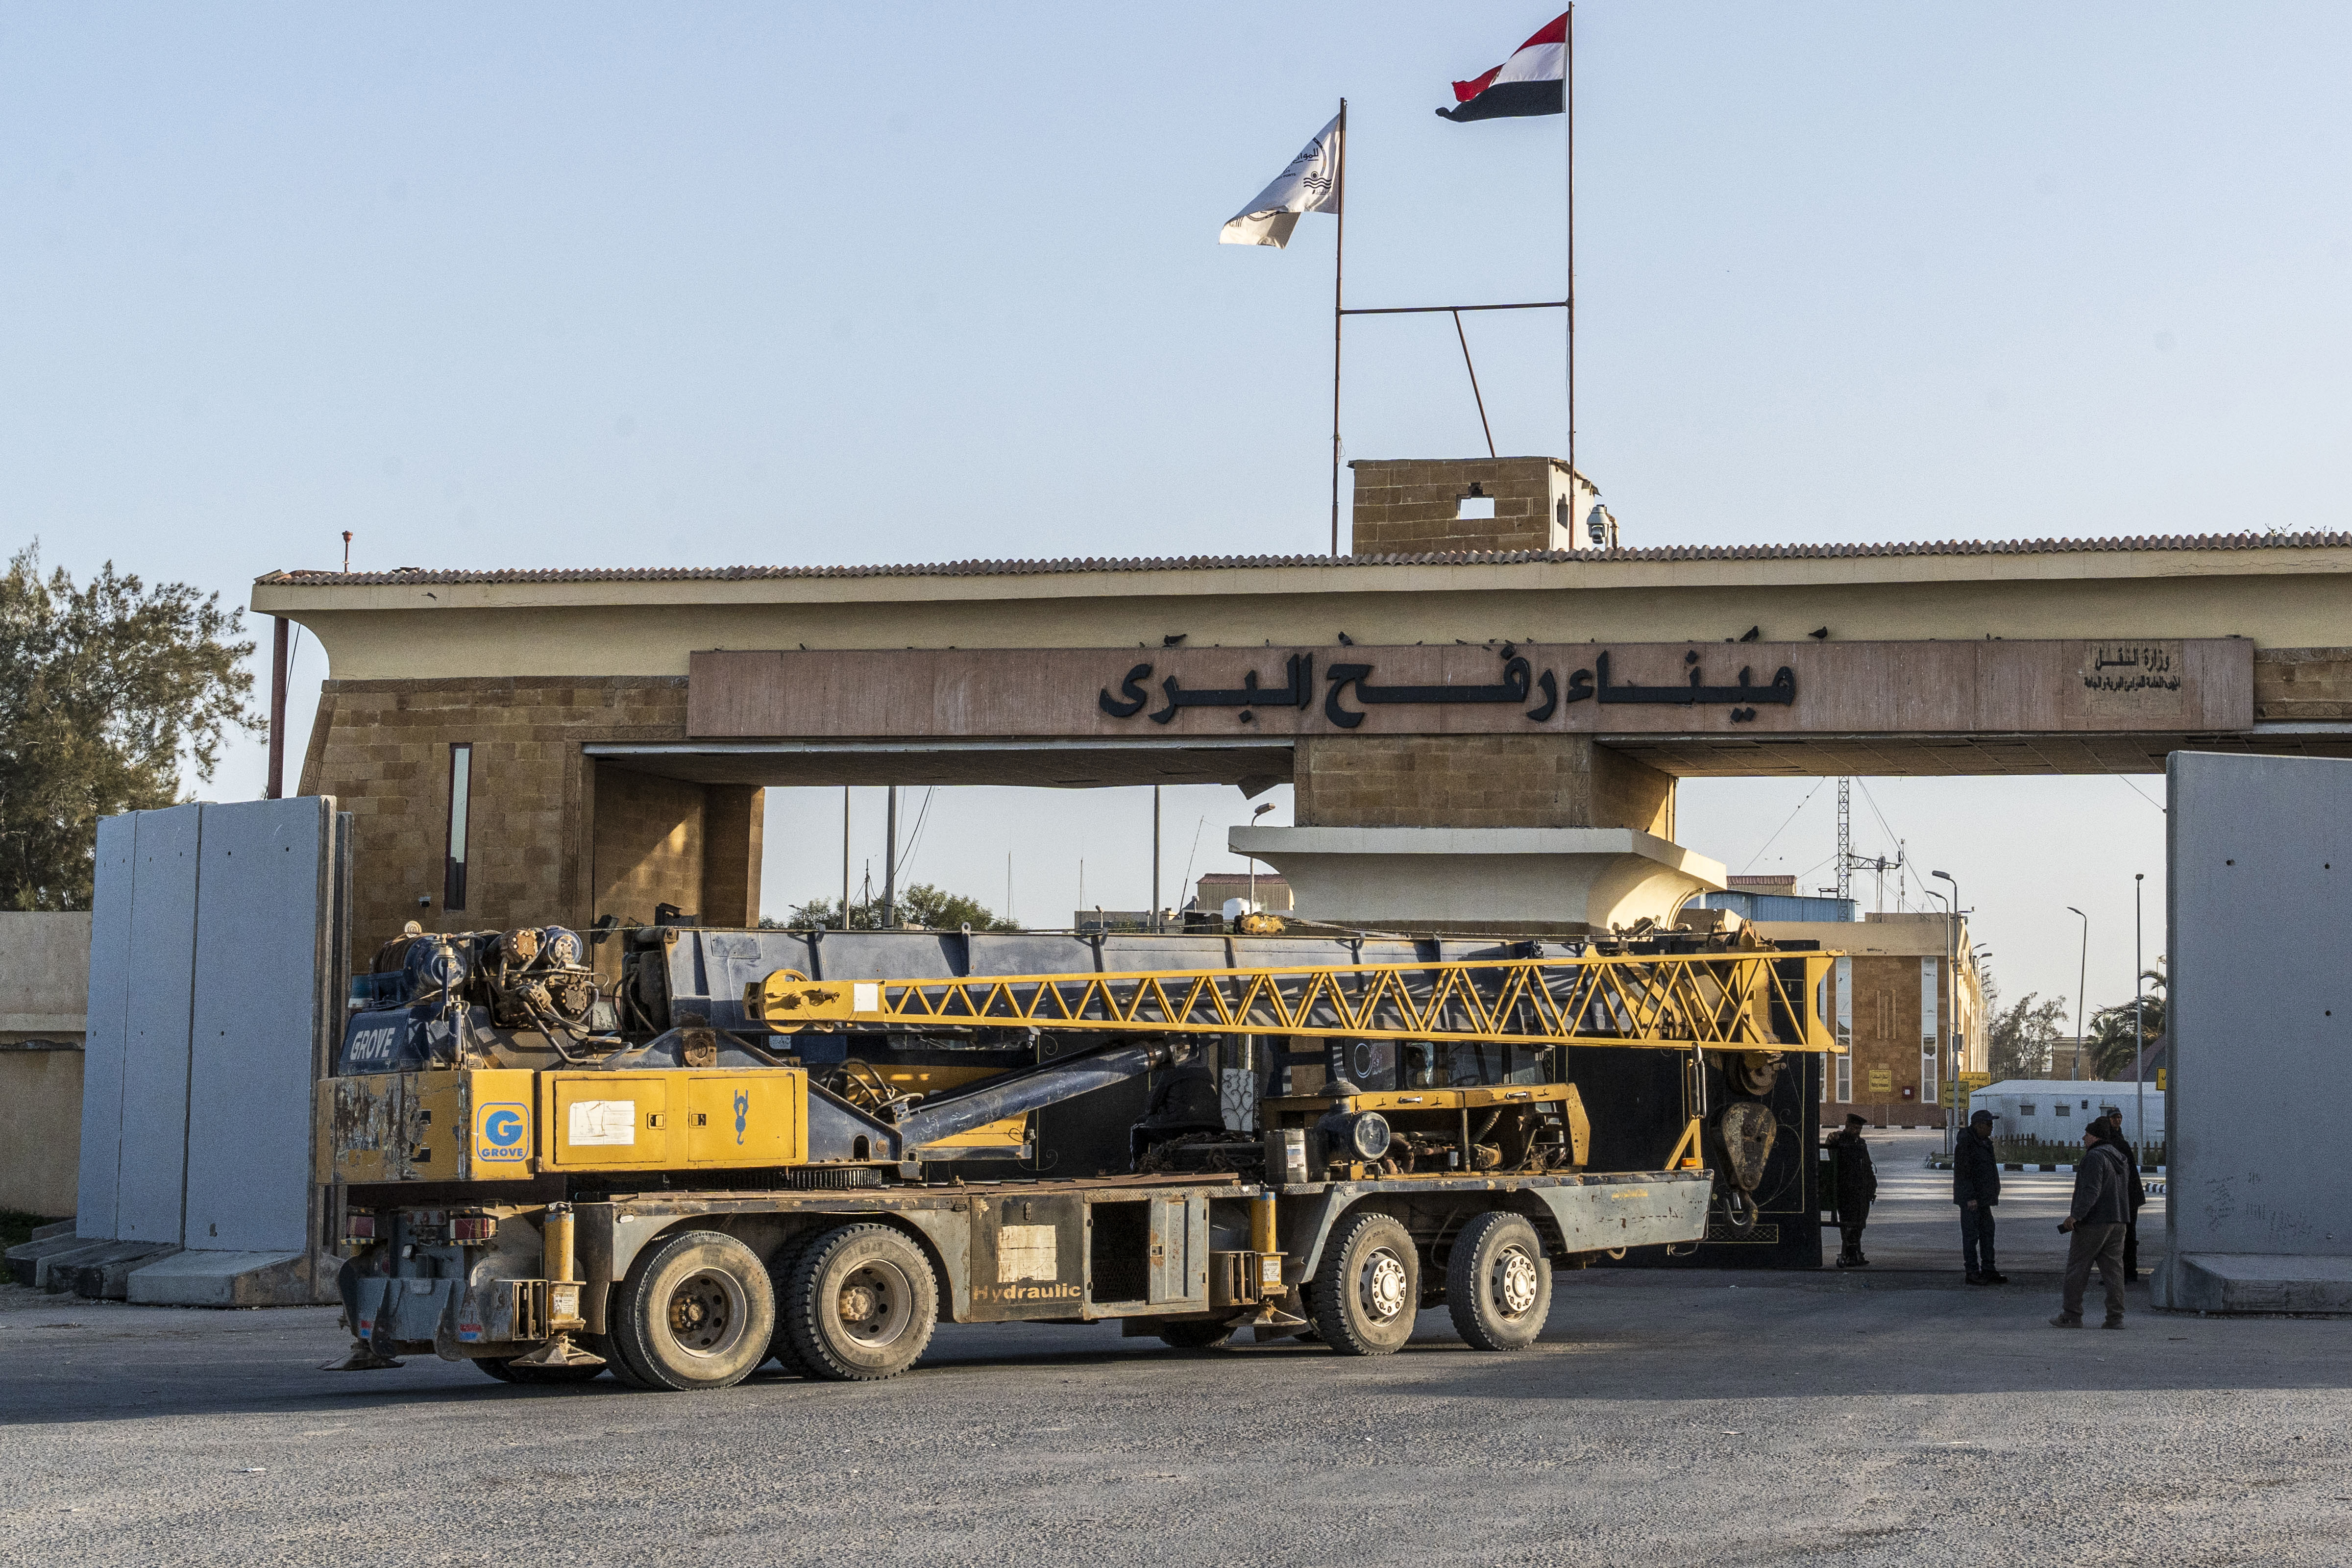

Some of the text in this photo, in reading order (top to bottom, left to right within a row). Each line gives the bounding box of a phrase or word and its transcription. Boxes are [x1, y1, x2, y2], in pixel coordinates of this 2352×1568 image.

[2095, 647, 2170, 672] وزارة النقل
[1325, 644, 1557, 728] رفح
[1568, 649, 1795, 723] ميناء
[350, 1027, 396, 1060] GROVE
[486, 1110, 523, 1147] G
[482, 1148, 523, 1157] GROVE
[973, 1283, 1081, 1303] Hydraulic
